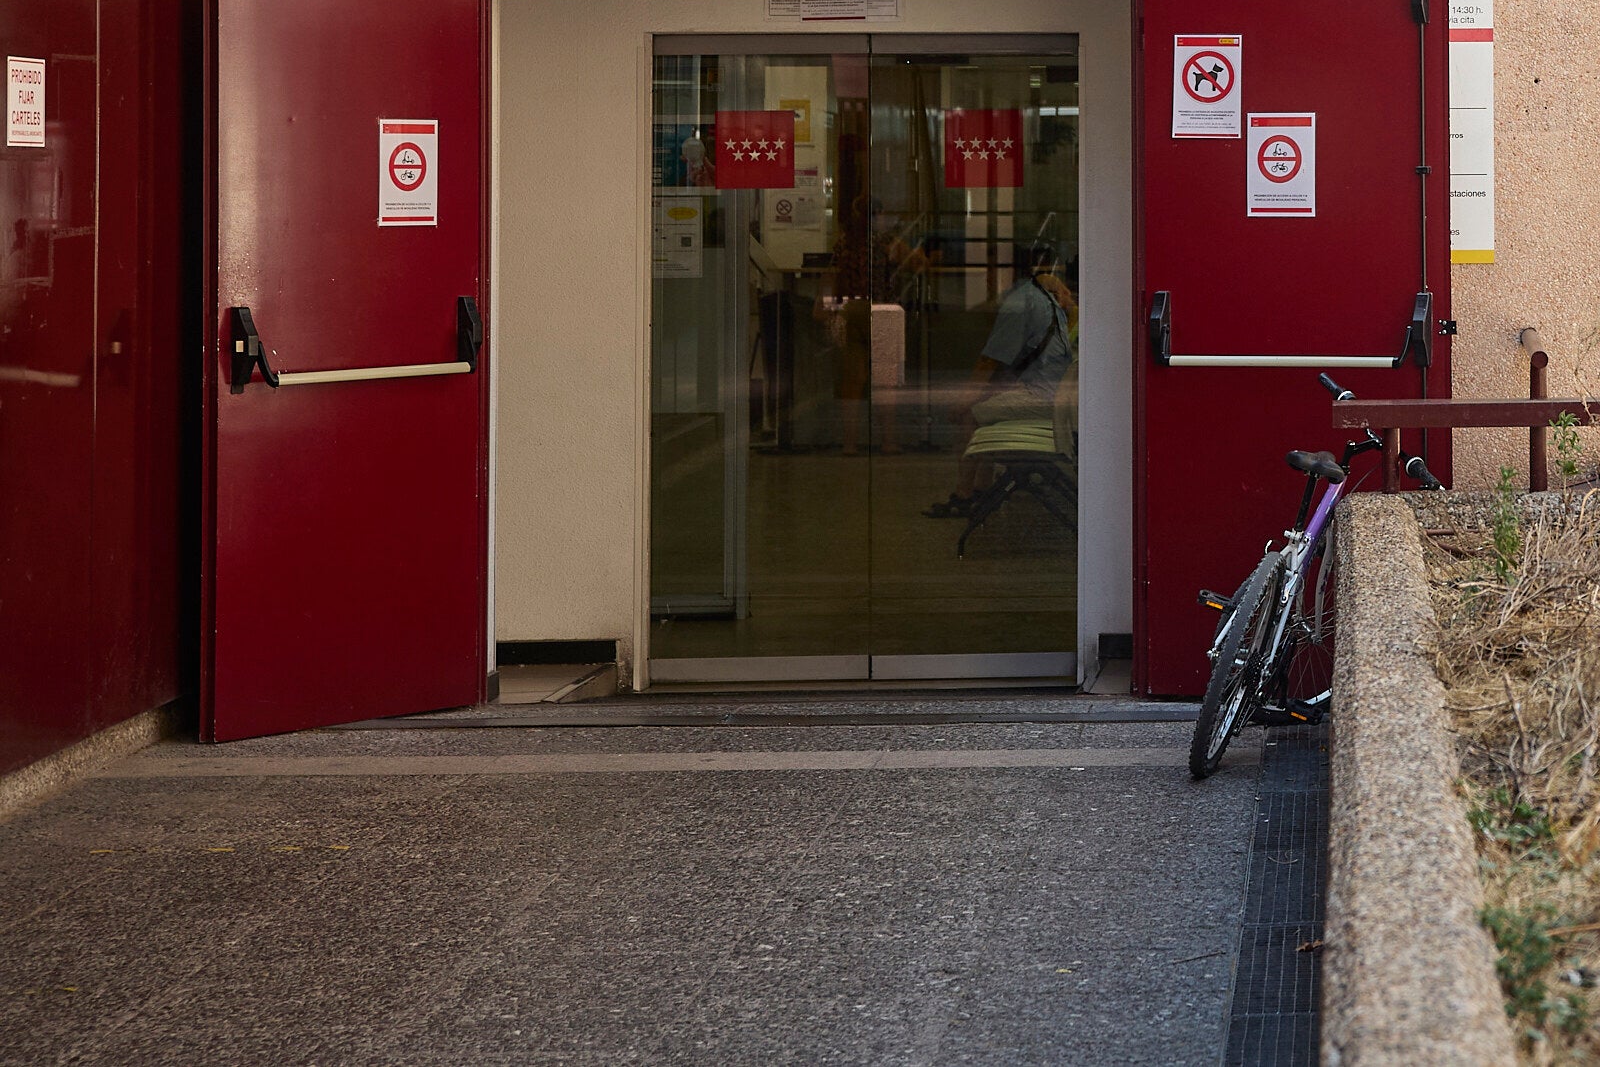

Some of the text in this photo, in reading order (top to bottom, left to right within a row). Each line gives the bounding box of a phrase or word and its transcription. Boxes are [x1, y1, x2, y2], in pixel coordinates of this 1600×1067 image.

[1452, 6, 1483, 14] 14:30 h.
[12, 68, 42, 85] PROHIBIDO
[19, 90, 34, 105] FIJAR
[12, 110, 41, 126] CARTELES
